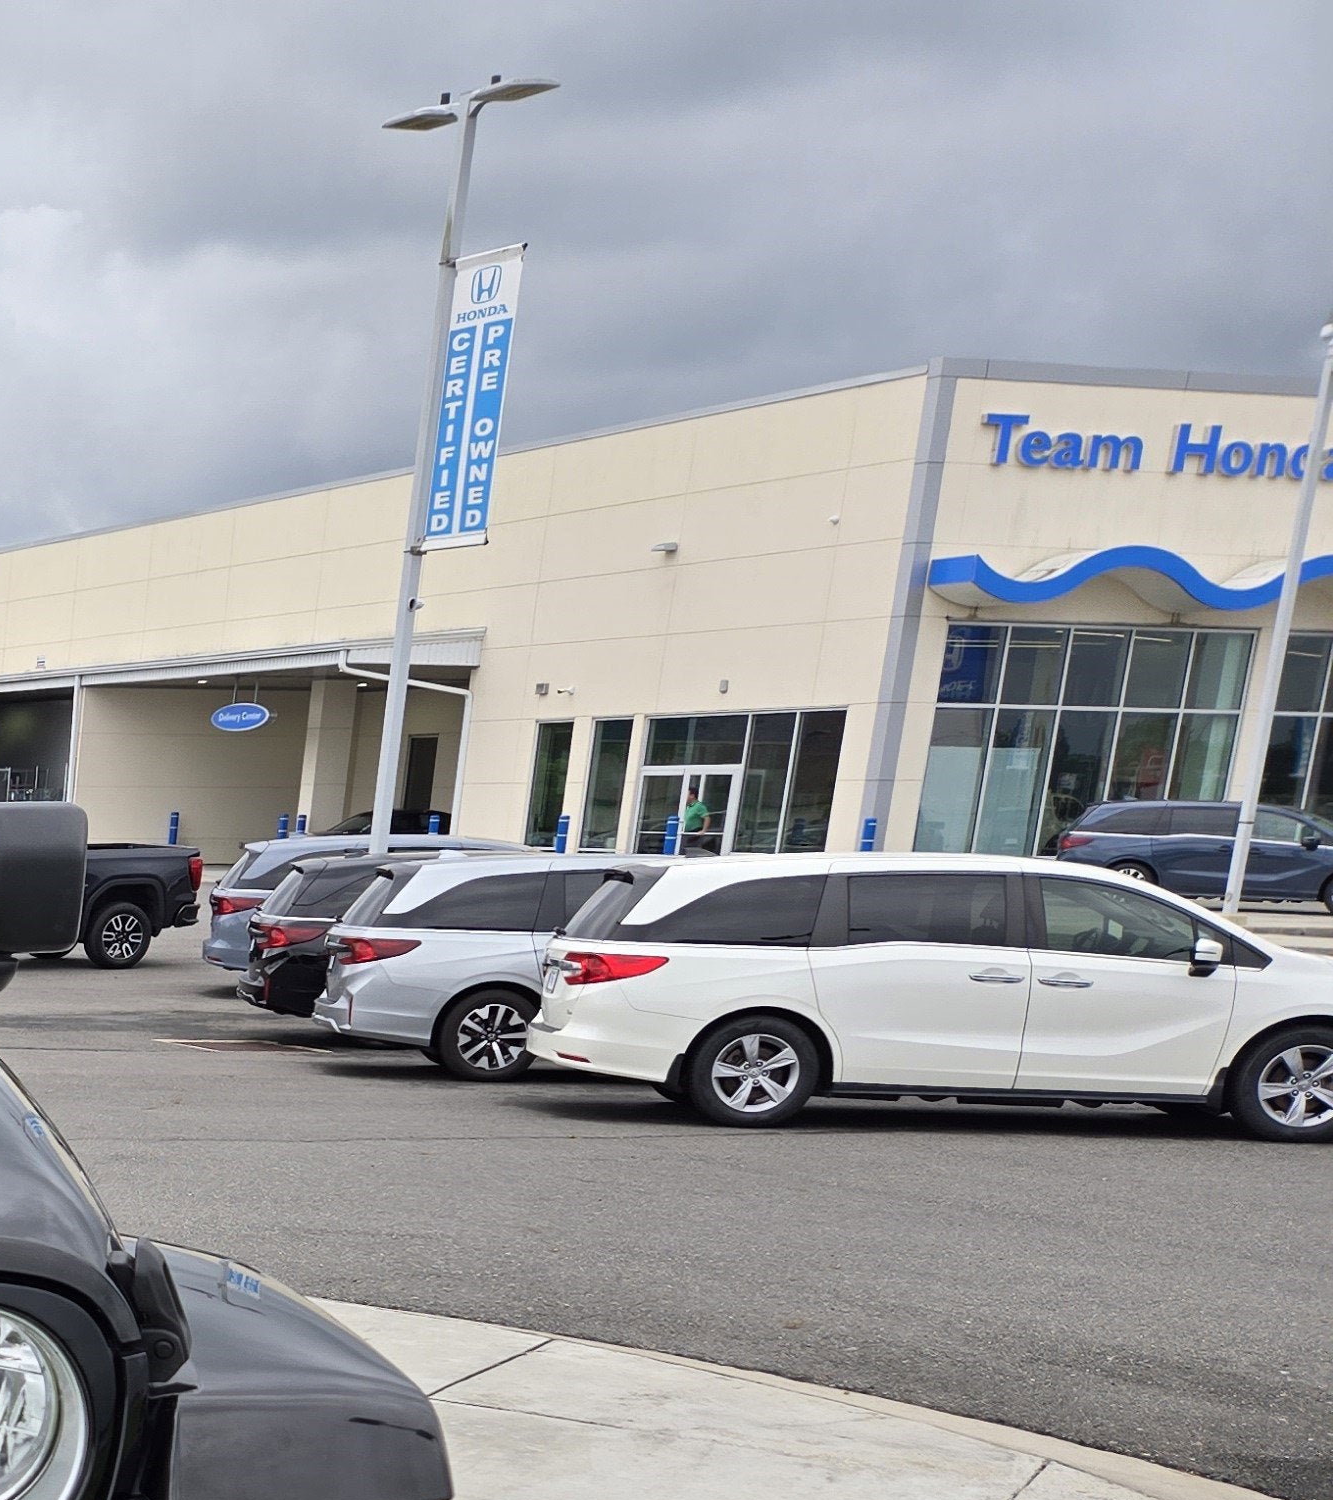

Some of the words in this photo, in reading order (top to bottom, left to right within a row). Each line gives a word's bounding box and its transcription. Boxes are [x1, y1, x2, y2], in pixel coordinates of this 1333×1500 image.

[456, 303, 508, 324] HONDA
[481, 325, 505, 392] PRE
[430, 332, 471, 532] CERTIFIED
[983, 412, 1144, 472] Team
[464, 417, 495, 529] OWNED
